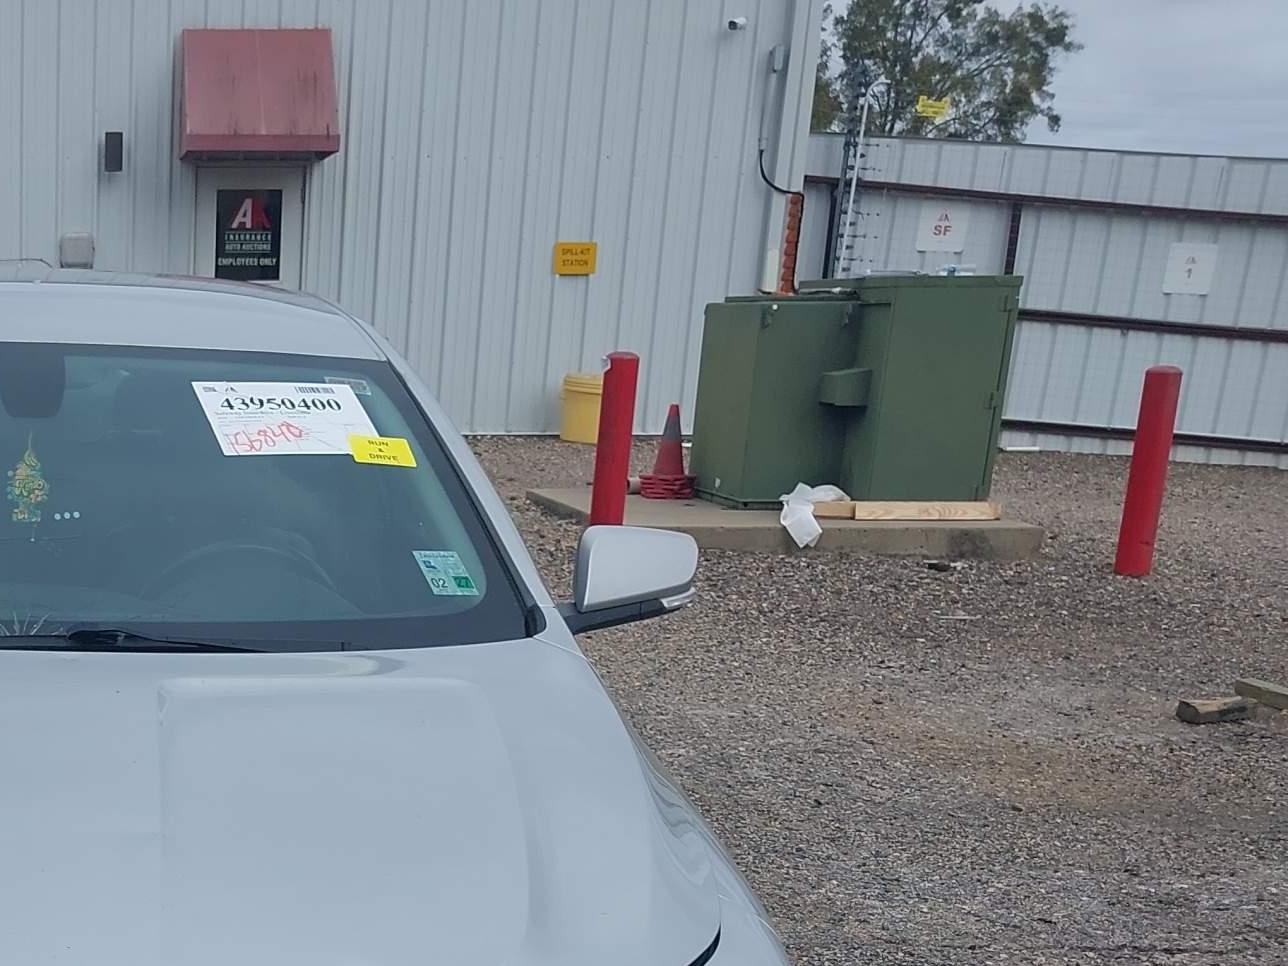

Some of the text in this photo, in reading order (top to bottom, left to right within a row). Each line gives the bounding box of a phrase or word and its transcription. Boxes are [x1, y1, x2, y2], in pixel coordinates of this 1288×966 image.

[933, 225, 953, 236] SF
[217, 257, 277, 266] EMPLOYEES ONLY
[220, 397, 342, 412] 43950400
[369, 453, 399, 461] DRIVE
[431, 577, 448, 588] 02
